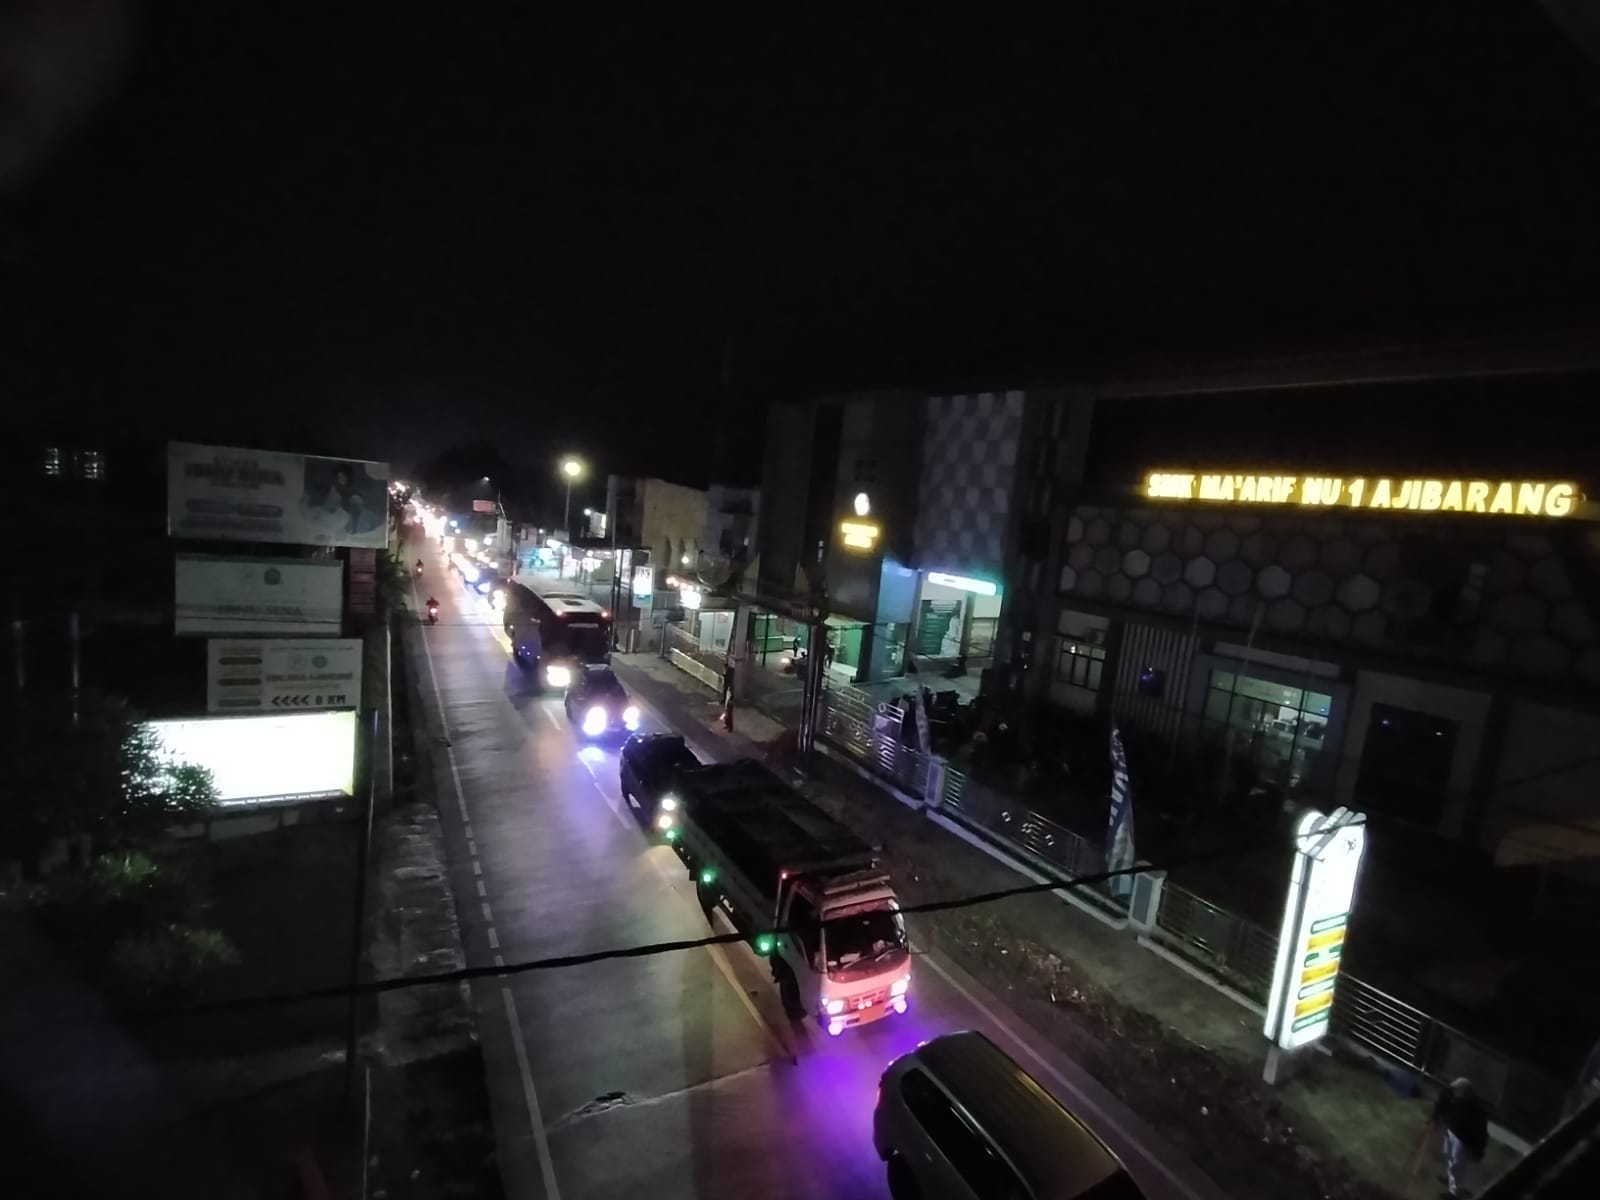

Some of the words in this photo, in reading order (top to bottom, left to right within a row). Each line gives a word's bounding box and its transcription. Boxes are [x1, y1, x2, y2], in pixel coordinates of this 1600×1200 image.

[1199, 475, 1297, 503] MA'ARIF
[1301, 477, 1343, 505] NU
[1348, 479, 1365, 507] 1
[1369, 479, 1573, 517] AJIBARANG
